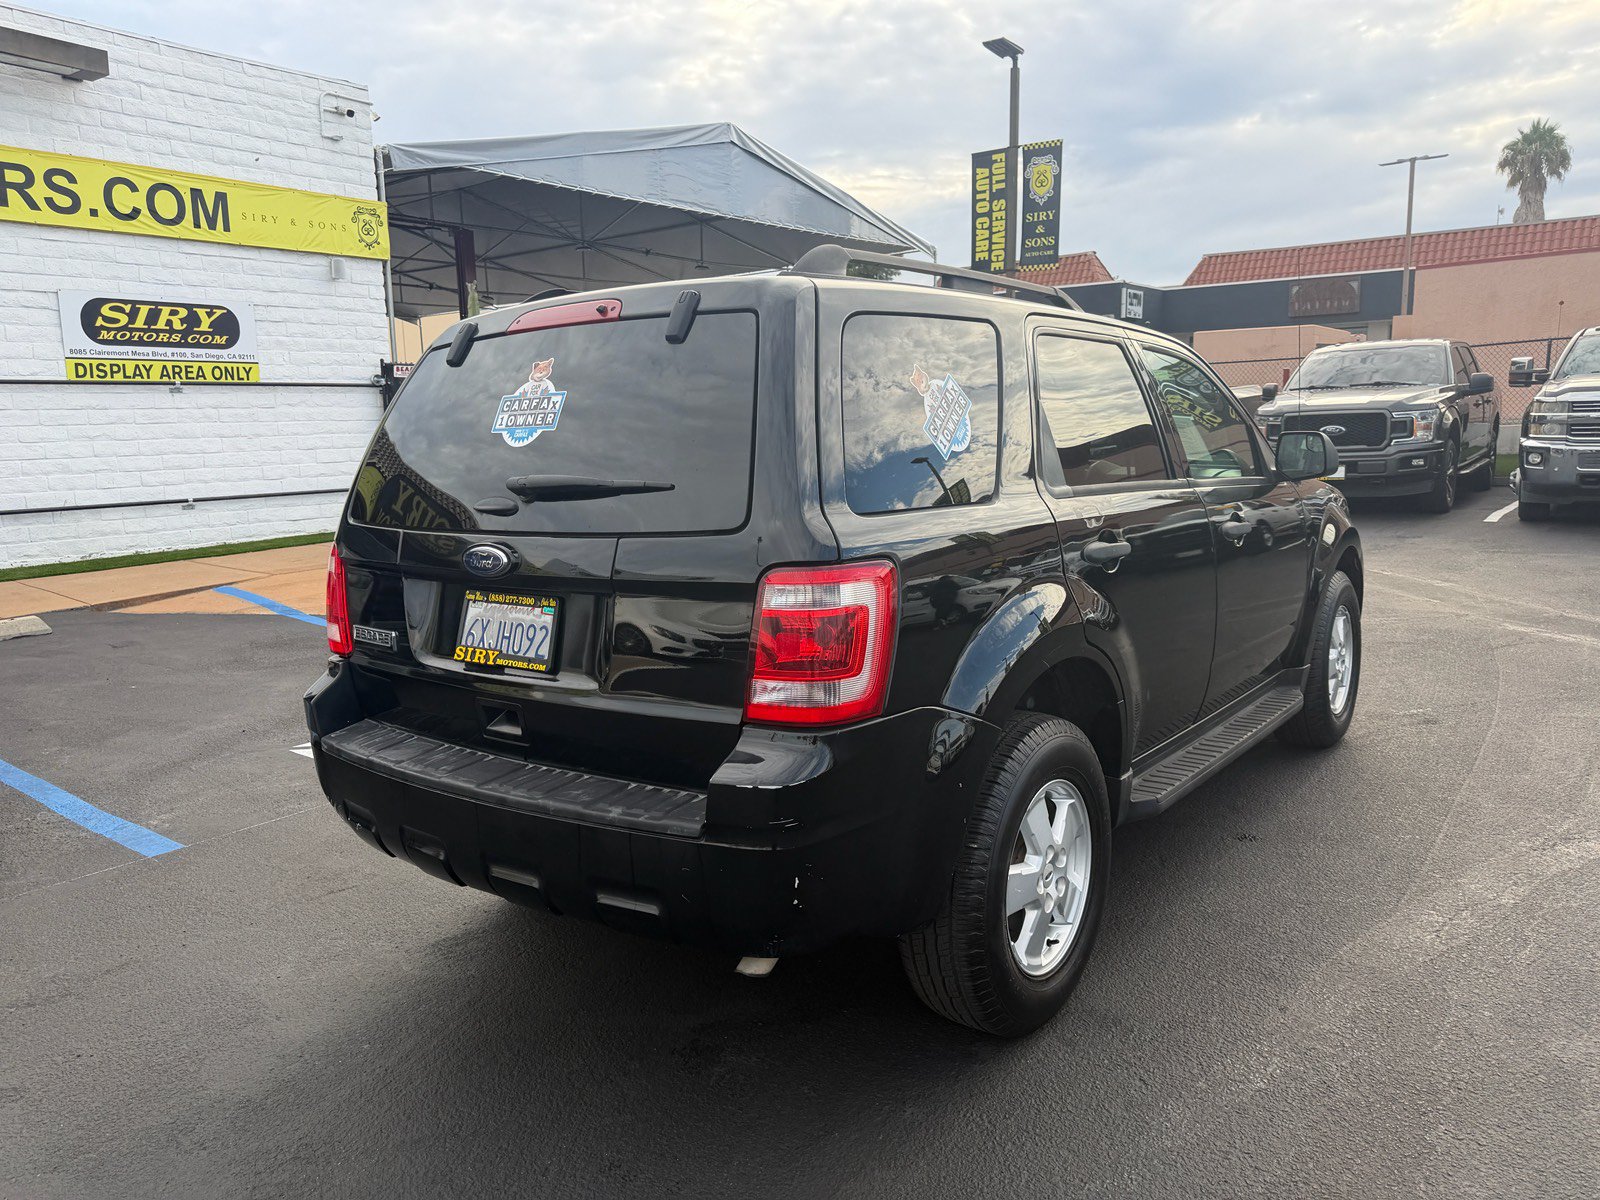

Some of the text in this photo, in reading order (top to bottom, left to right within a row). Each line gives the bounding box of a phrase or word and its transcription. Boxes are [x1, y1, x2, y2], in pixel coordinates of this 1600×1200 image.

[975, 167, 990, 262] AUTO CARE
[990, 152, 1006, 272] FULL SERVICE
[1025, 210, 1056, 223] SIRY
[241, 212, 347, 232] SIRY & SONS
[1035, 225, 1046, 234] &
[1024, 236, 1055, 249] SONS
[94, 302, 228, 332] SIRY
[97, 330, 230, 345] MOTORS.COM
[89, 348, 130, 356] Clairemont
[74, 362, 253, 381] DISPLAY AREA ONLY
[503, 398, 560, 413] CARFAX
[929, 385, 960, 436] CARFAX
[470, 551, 494, 568] Ford
[505, 595, 535, 606] 277-7300
[465, 618, 549, 660] 6XJH092
[453, 646, 547, 671] SIRY MOTORS.COM
